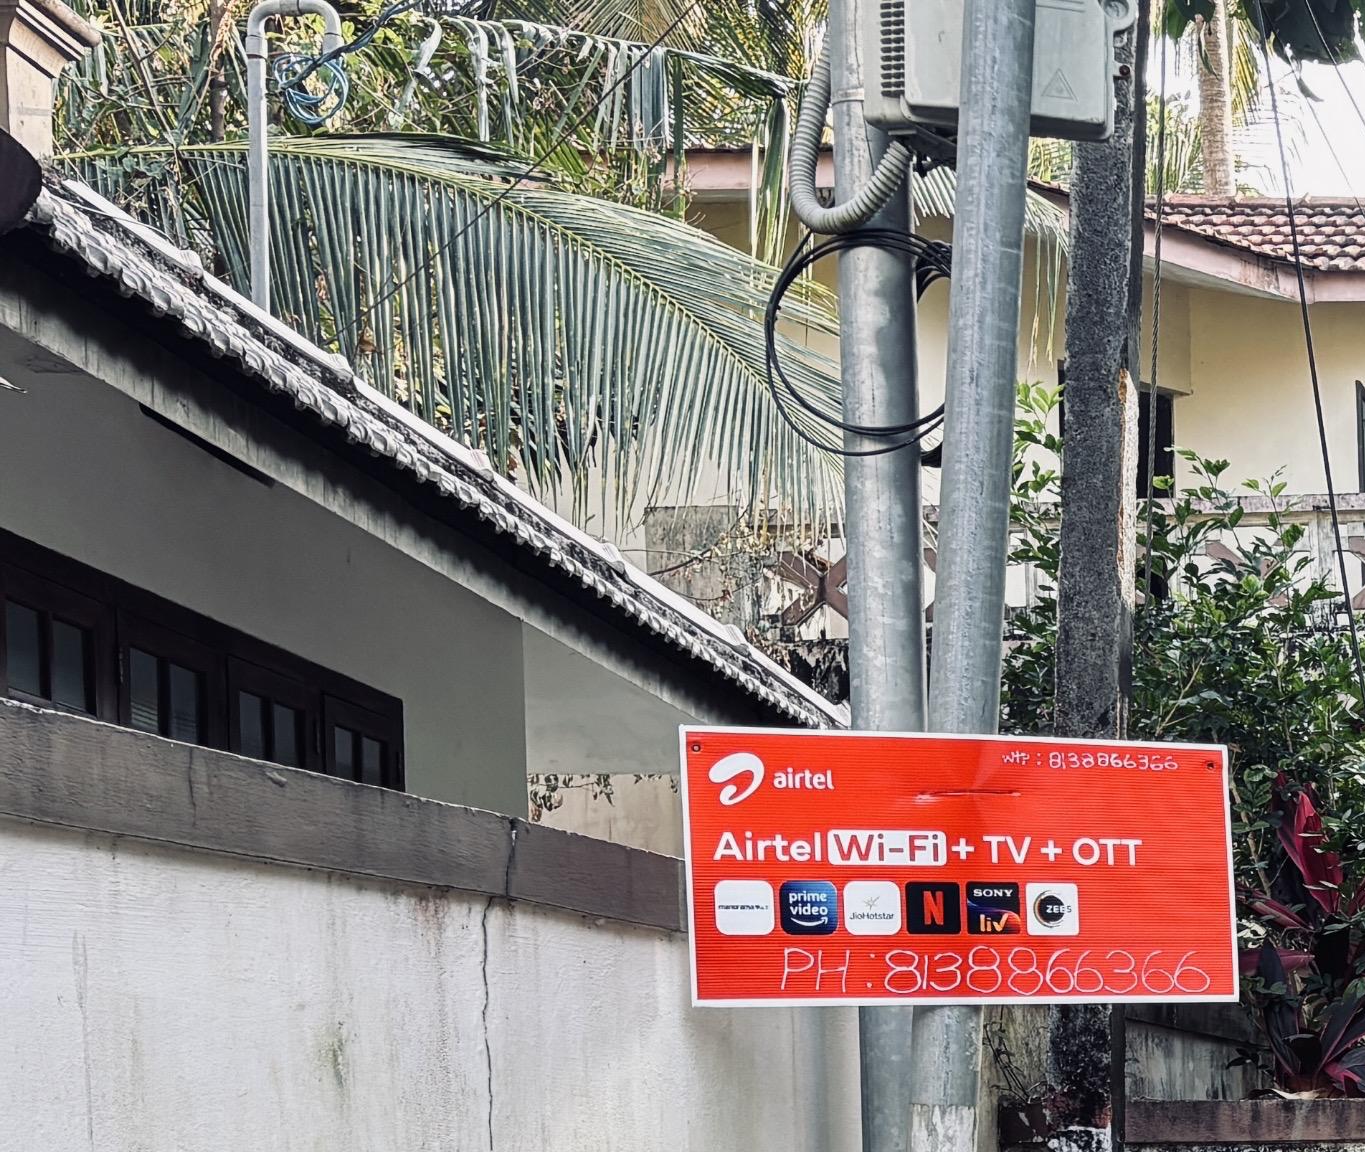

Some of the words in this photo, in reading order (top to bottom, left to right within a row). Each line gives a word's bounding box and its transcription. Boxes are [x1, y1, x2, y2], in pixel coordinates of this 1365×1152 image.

[774, 768, 834, 789] airtel
[712, 831, 823, 862] Airtel
[833, 833, 940, 862] Wi-Fi
[951, 838, 974, 860] +
[983, 835, 1031, 864] TV
[1040, 840, 1062, 861] +
[1072, 838, 1142, 866] OTT
[789, 891, 827, 902] prime
[973, 888, 1013, 897] SONY
[790, 903, 828, 915] video
[850, 912, 894, 920] JioHotstar
[923, 891, 944, 925] N
[884, 945, 1211, 996] 8138866366
